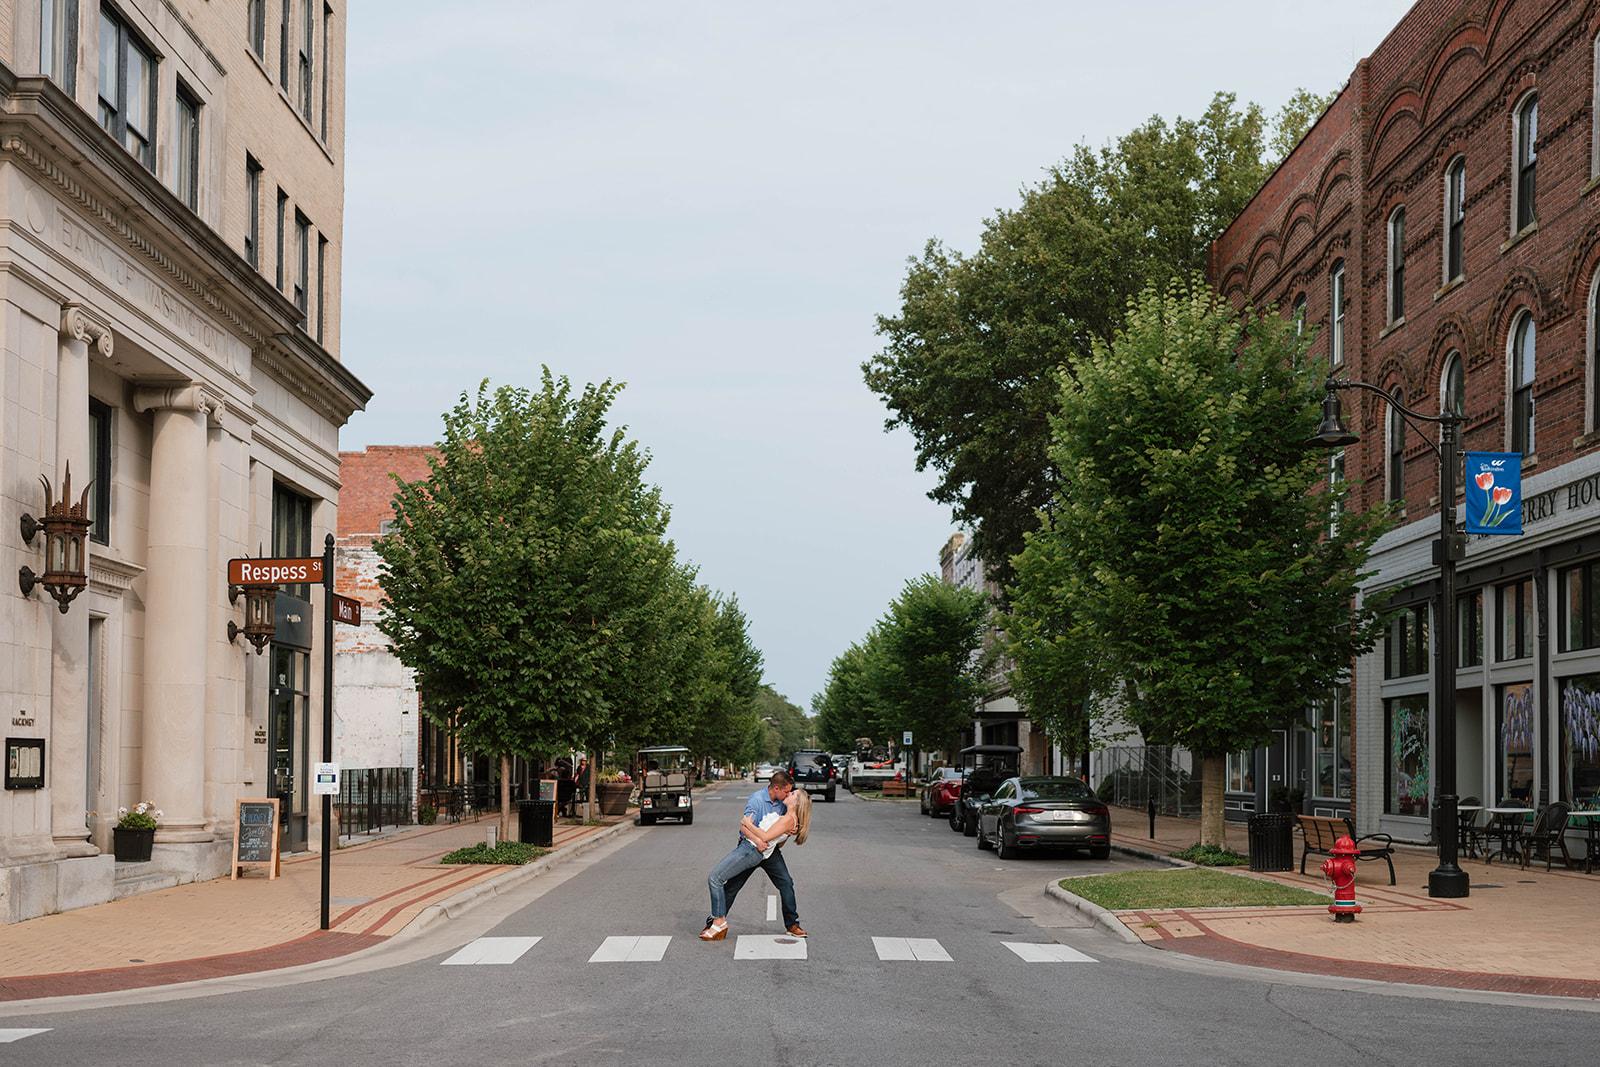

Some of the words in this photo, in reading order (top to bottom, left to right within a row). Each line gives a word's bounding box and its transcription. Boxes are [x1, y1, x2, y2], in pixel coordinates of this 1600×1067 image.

[63, 217, 106, 275] BANK
[115, 259, 135, 286] OF
[143, 278, 219, 355] WASHINGTON
[241, 563, 307, 583] Respess
[312, 561, 321, 571] St
[338, 600, 353, 620] Main
